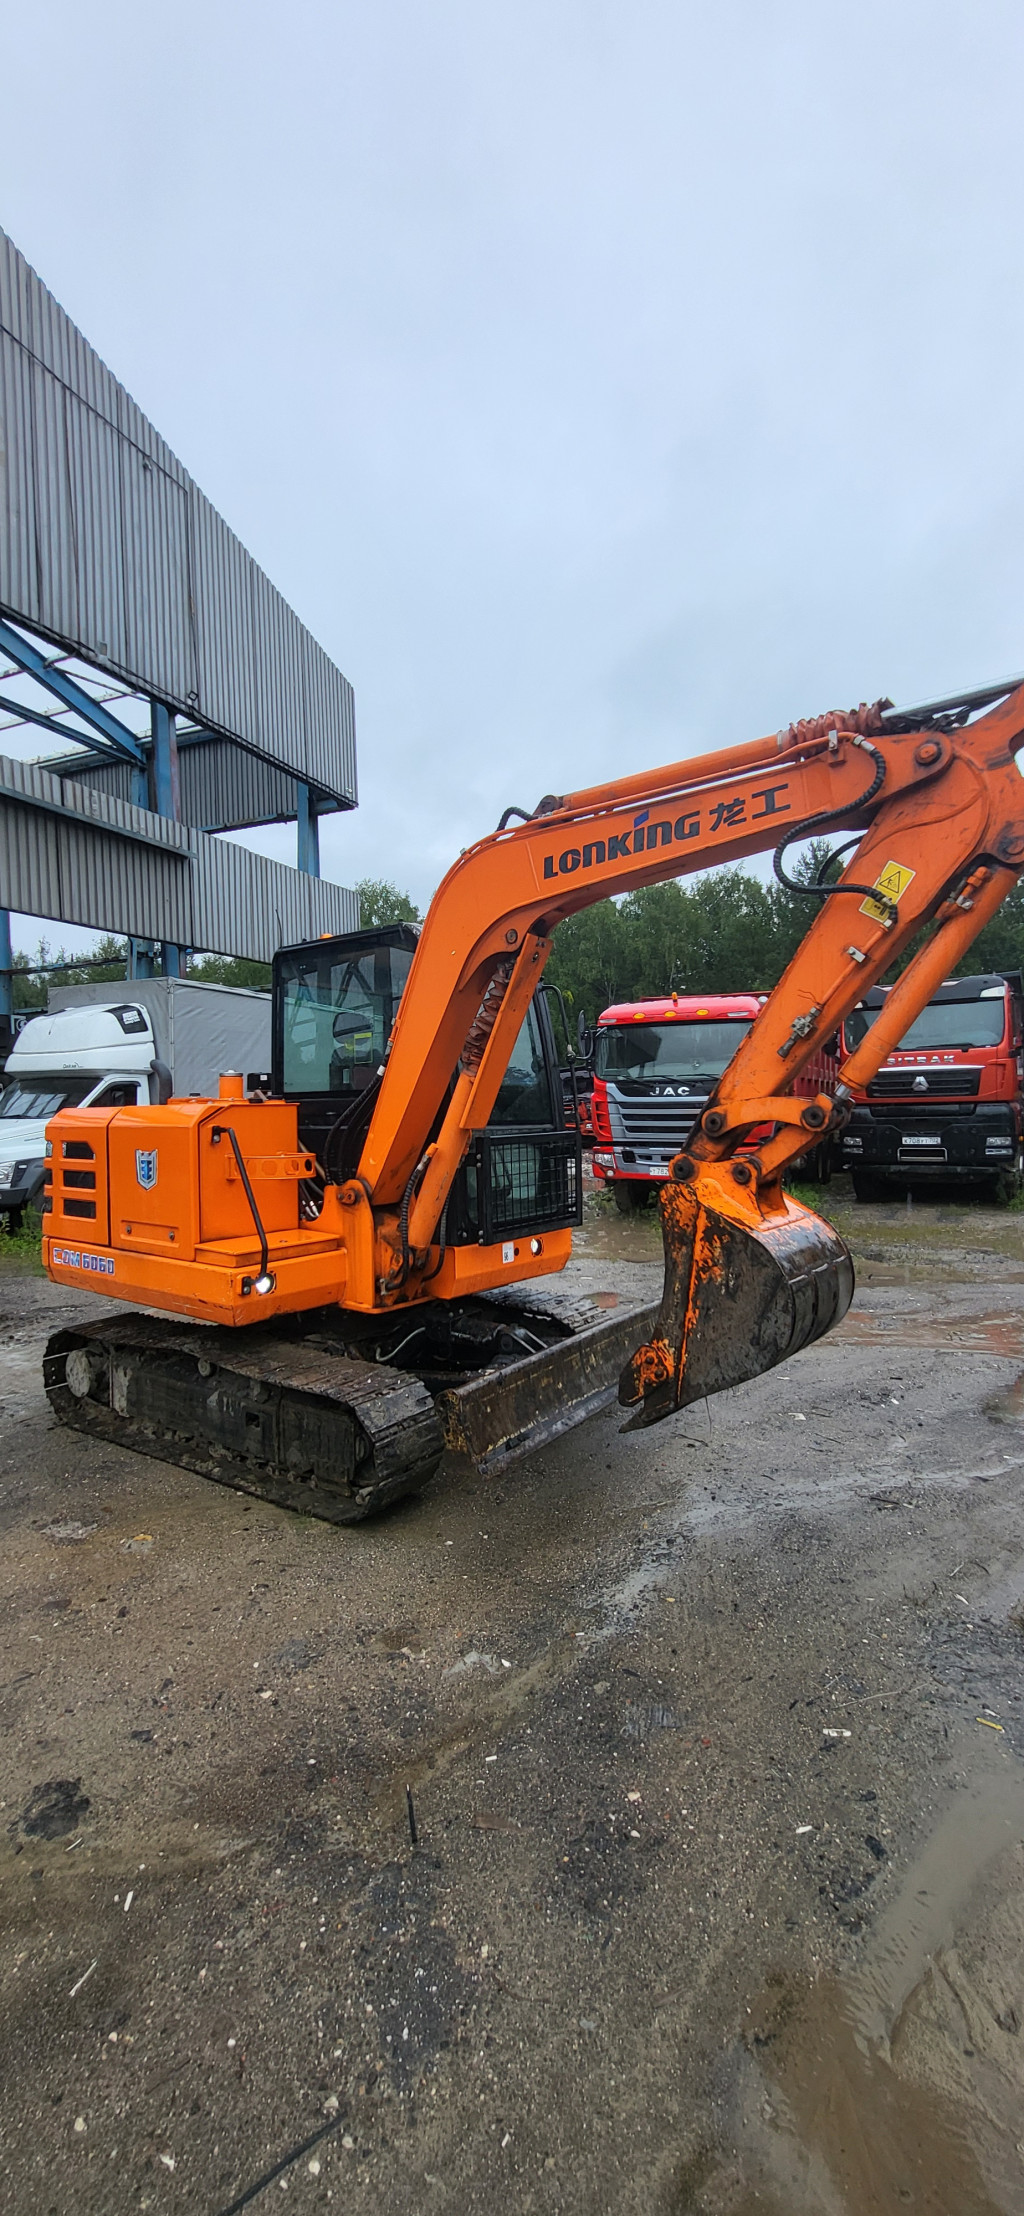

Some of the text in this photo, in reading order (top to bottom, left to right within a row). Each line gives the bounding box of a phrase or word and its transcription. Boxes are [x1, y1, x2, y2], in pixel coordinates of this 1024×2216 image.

[709, 783, 791, 832] 龙工
[543, 810, 701, 879] LONKING
[649, 1086, 690, 1096] JAC
[82, 1252, 115, 1276] 6060
